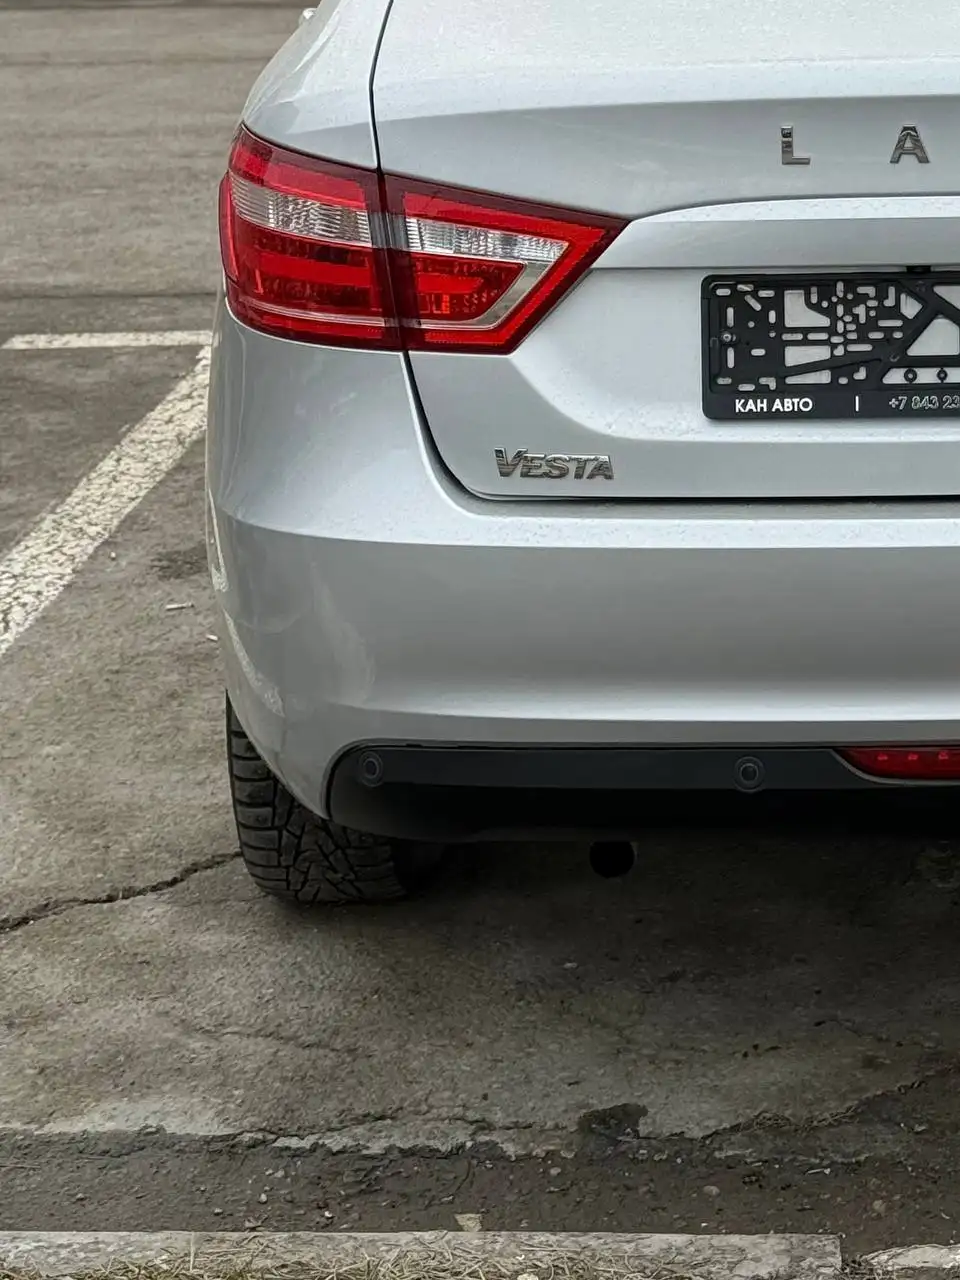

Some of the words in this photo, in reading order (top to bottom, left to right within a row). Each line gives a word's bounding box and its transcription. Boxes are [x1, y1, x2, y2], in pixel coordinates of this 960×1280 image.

[735, 398, 768, 413] КАН
[771, 397, 814, 412] АВТО
[888, 396, 908, 410] +7
[493, 446, 615, 481] VESTA
